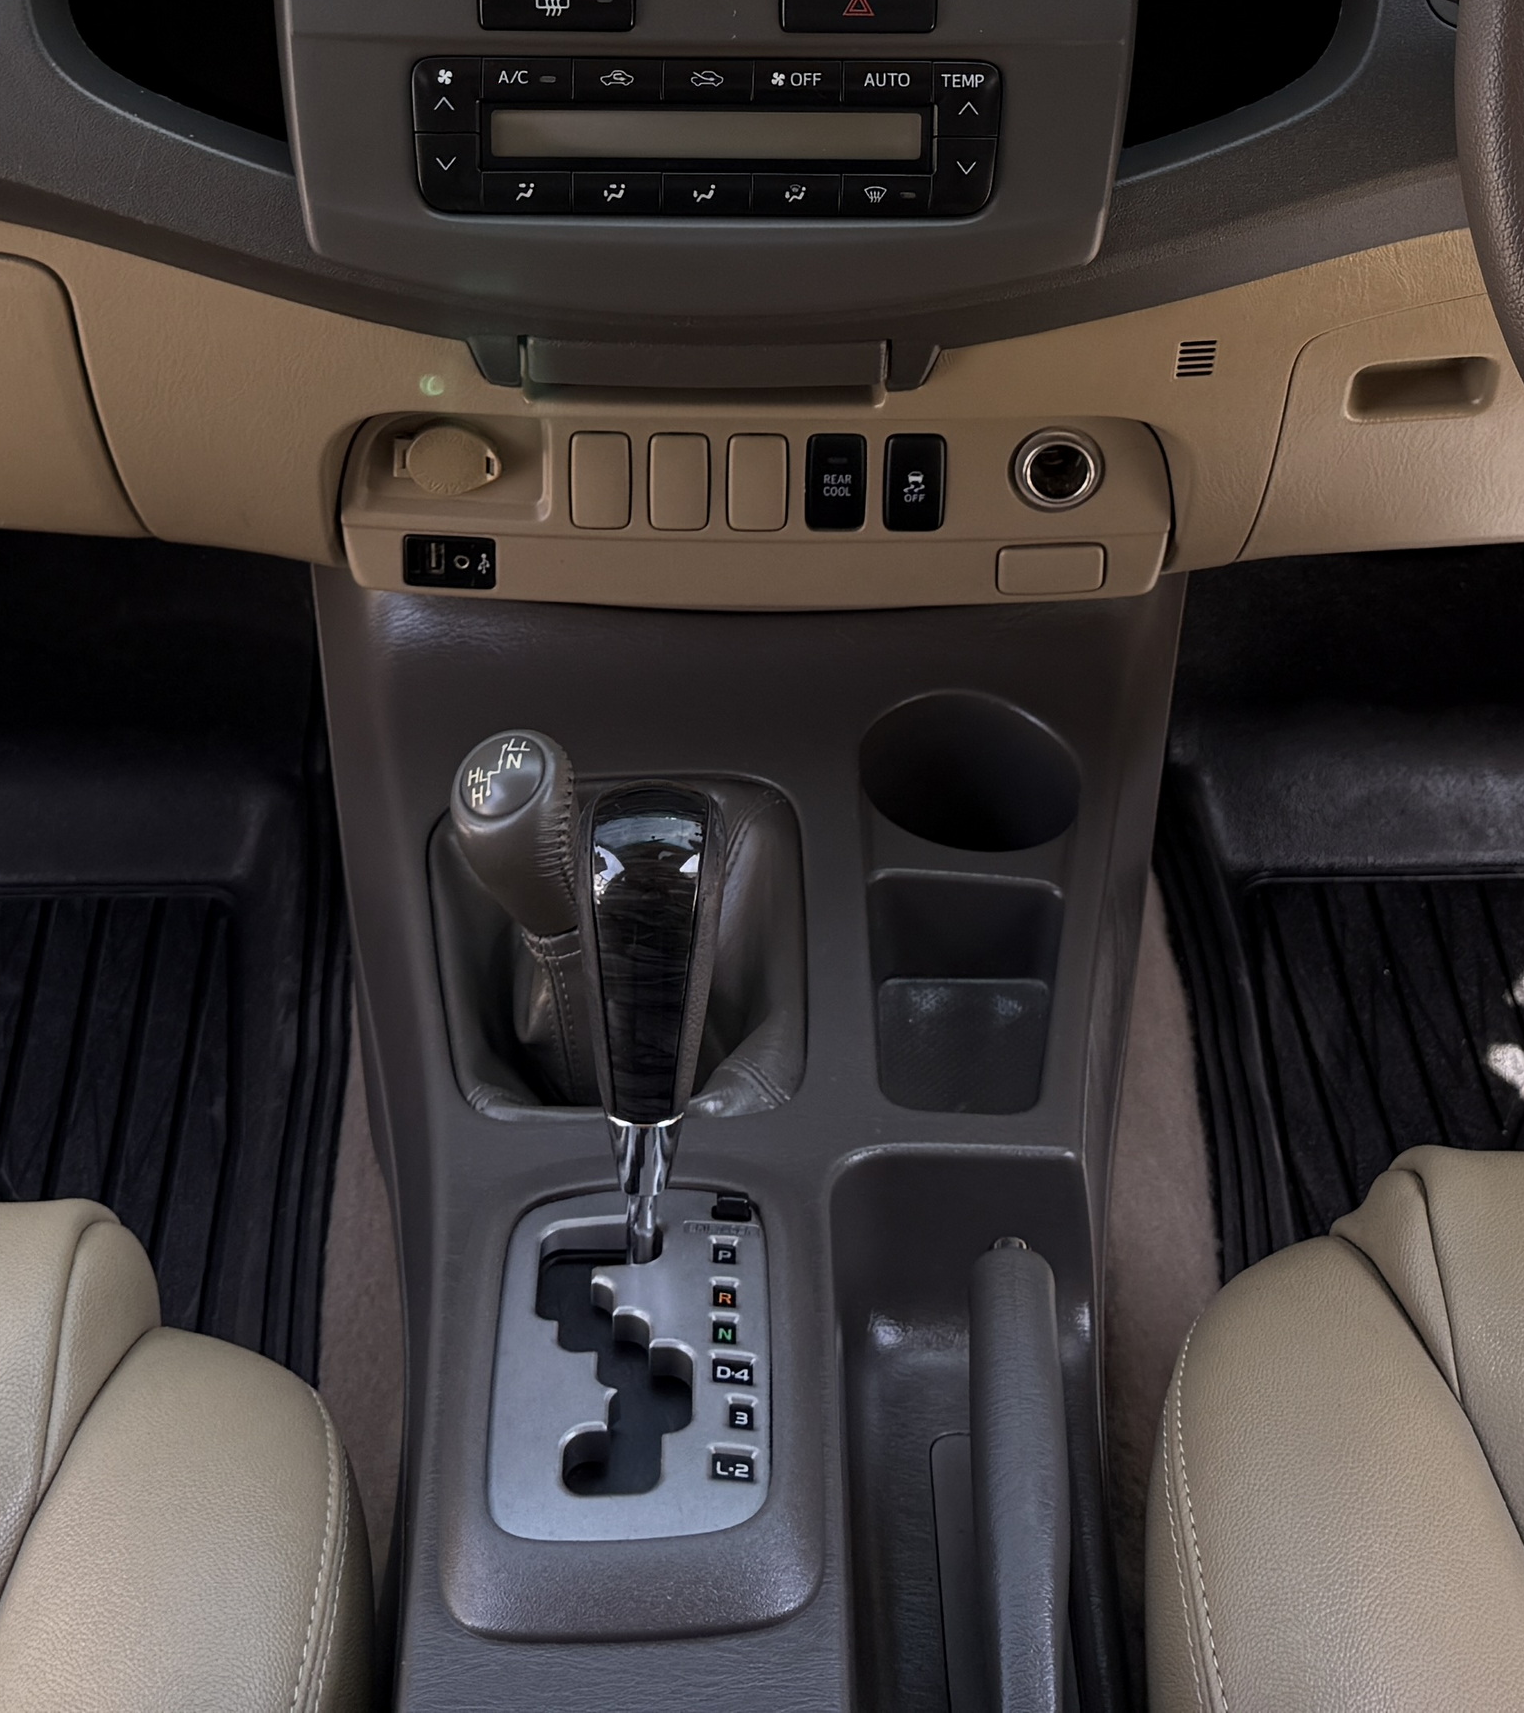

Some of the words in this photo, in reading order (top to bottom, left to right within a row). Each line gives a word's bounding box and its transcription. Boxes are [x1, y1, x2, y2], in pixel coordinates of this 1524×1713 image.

[498, 70, 529, 86] A/C
[790, 72, 822, 87] OFF
[864, 73, 910, 88] AUTO
[941, 74, 985, 88] TEMP
[823, 474, 852, 484] REAR
[823, 486, 851, 497] COOL
[904, 493, 926, 504] OFF
[505, 753, 523, 769] N
[472, 785, 484, 808] H
[717, 1249, 732, 1261] P
[718, 1291, 732, 1304] R
[718, 1328, 732, 1342] N
[734, 1412, 749, 1425] 3
